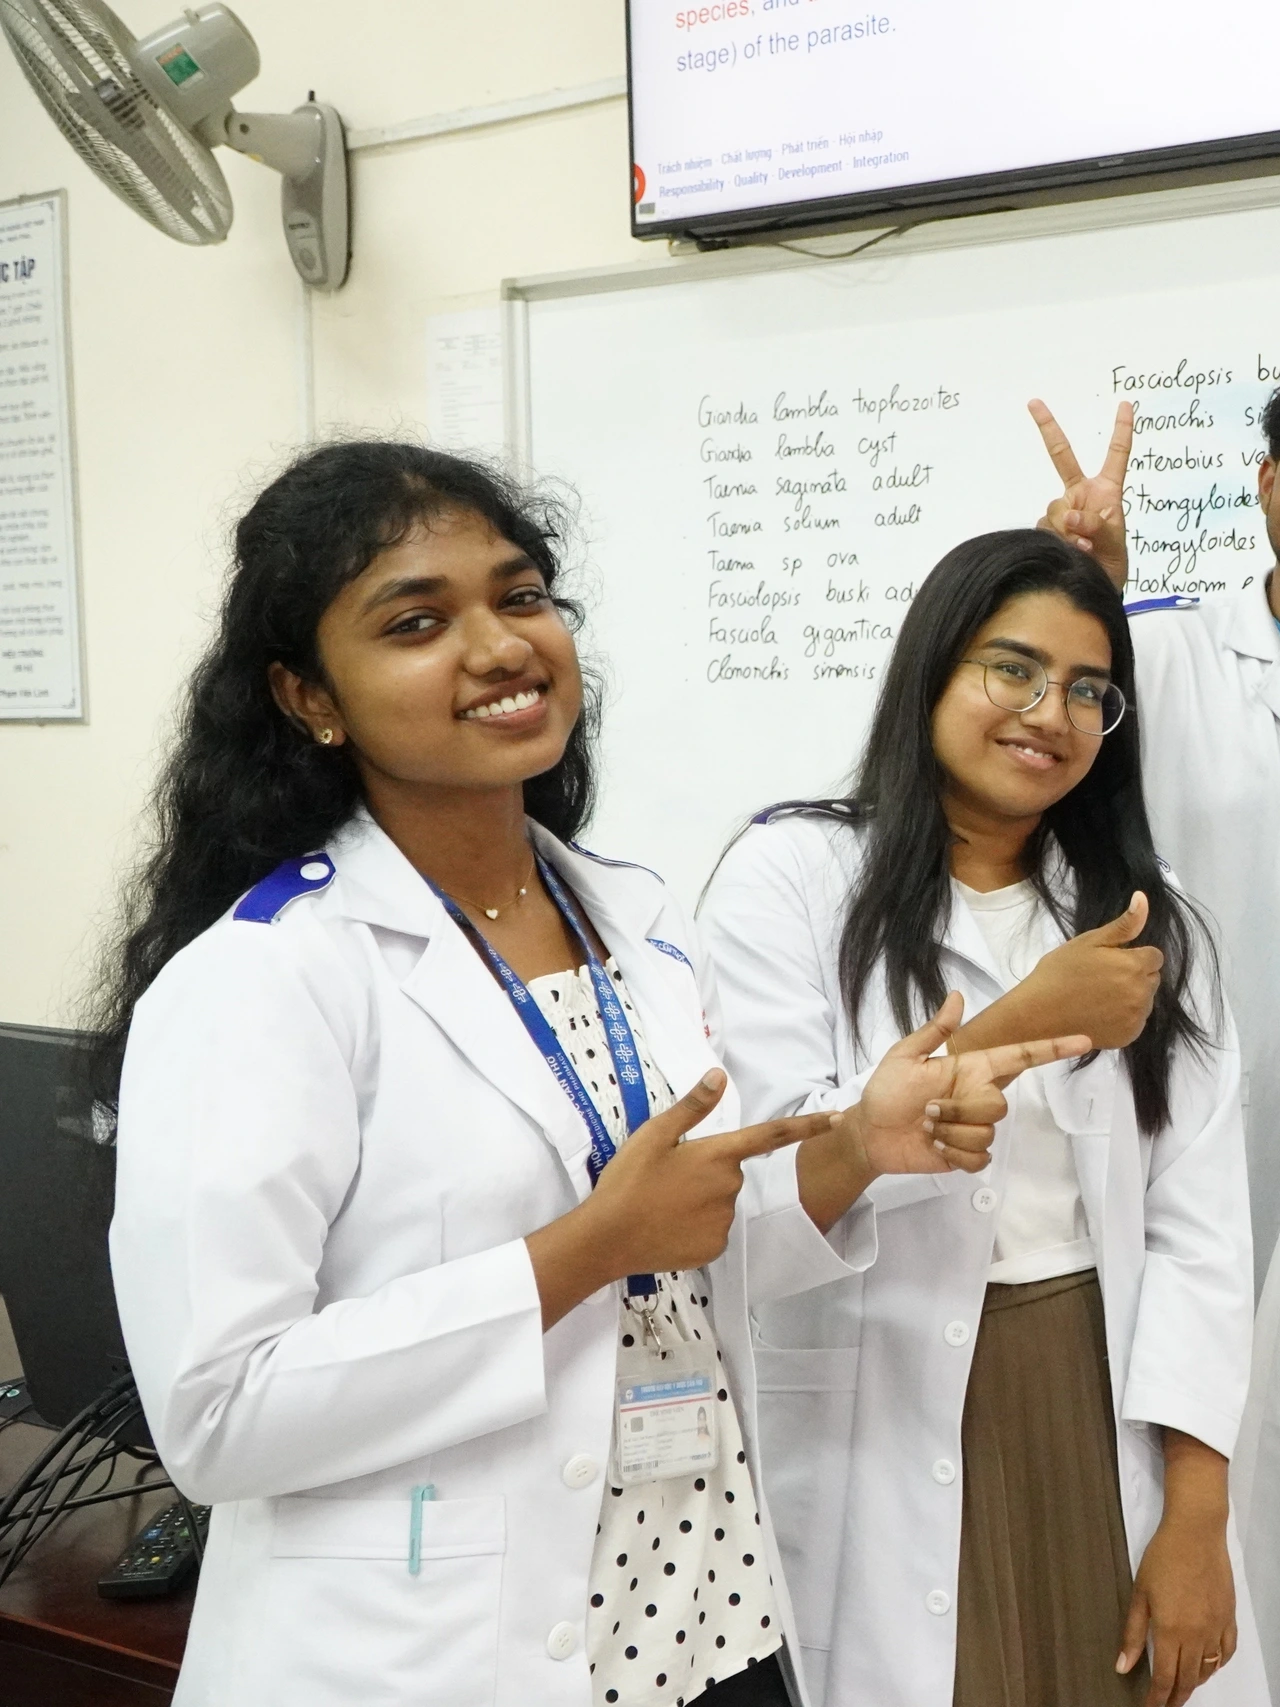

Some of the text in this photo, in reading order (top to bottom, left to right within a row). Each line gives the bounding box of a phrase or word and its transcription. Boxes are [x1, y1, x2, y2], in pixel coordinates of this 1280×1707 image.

[675, 0, 756, 32] species,
[676, 14, 897, 72] stage) of the parasite.
[659, 149, 910, 199] Responsibility Quality Development Integration
[1112, 358, 1233, 395] Fasciolopsis
[772, 389, 839, 422] lamblia
[851, 383, 961, 424] trophozoites
[1132, 398, 1215, 435] lonorchis
[774, 430, 836, 461] lamblia
[858, 430, 898, 468] cyst
[1126, 445, 1224, 472] nterobius
[775, 468, 848, 512] saginata
[872, 463, 935, 492] adult
[783, 504, 841, 533] solium
[874, 503, 923, 527] adult
[782, 556, 804, 578] sp
[826, 552, 860, 569] ova
[1126, 527, 1257, 575] trongyloides
[825, 578, 871, 605] buski
[802, 618, 895, 658] gigantica
[555, 1051, 581, 1091] PHARMACY
[577, 1091, 589, 1107] AND
[585, 1107, 606, 1143] MEDICINE
